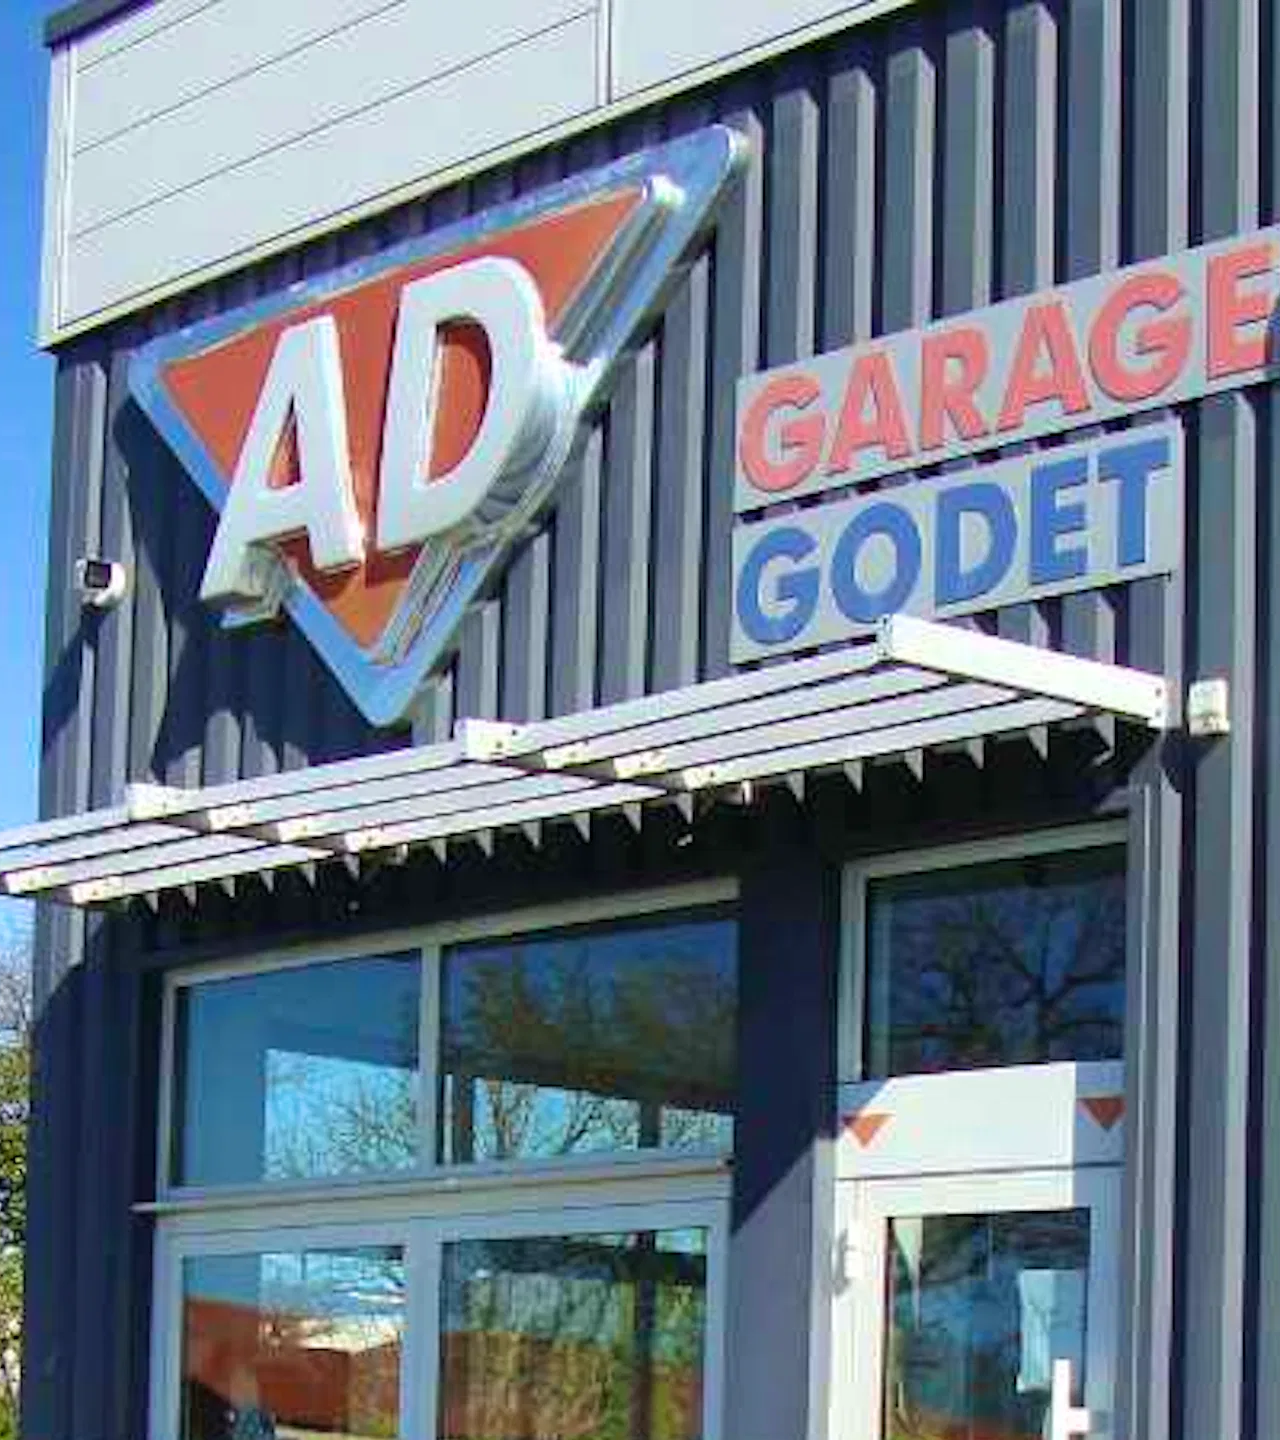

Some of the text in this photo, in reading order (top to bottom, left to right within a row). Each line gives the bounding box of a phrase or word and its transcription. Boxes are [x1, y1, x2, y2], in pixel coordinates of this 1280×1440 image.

[201, 255, 552, 602] AD
[740, 242, 1278, 494] GARAGE
[736, 436, 1173, 646] GODET
